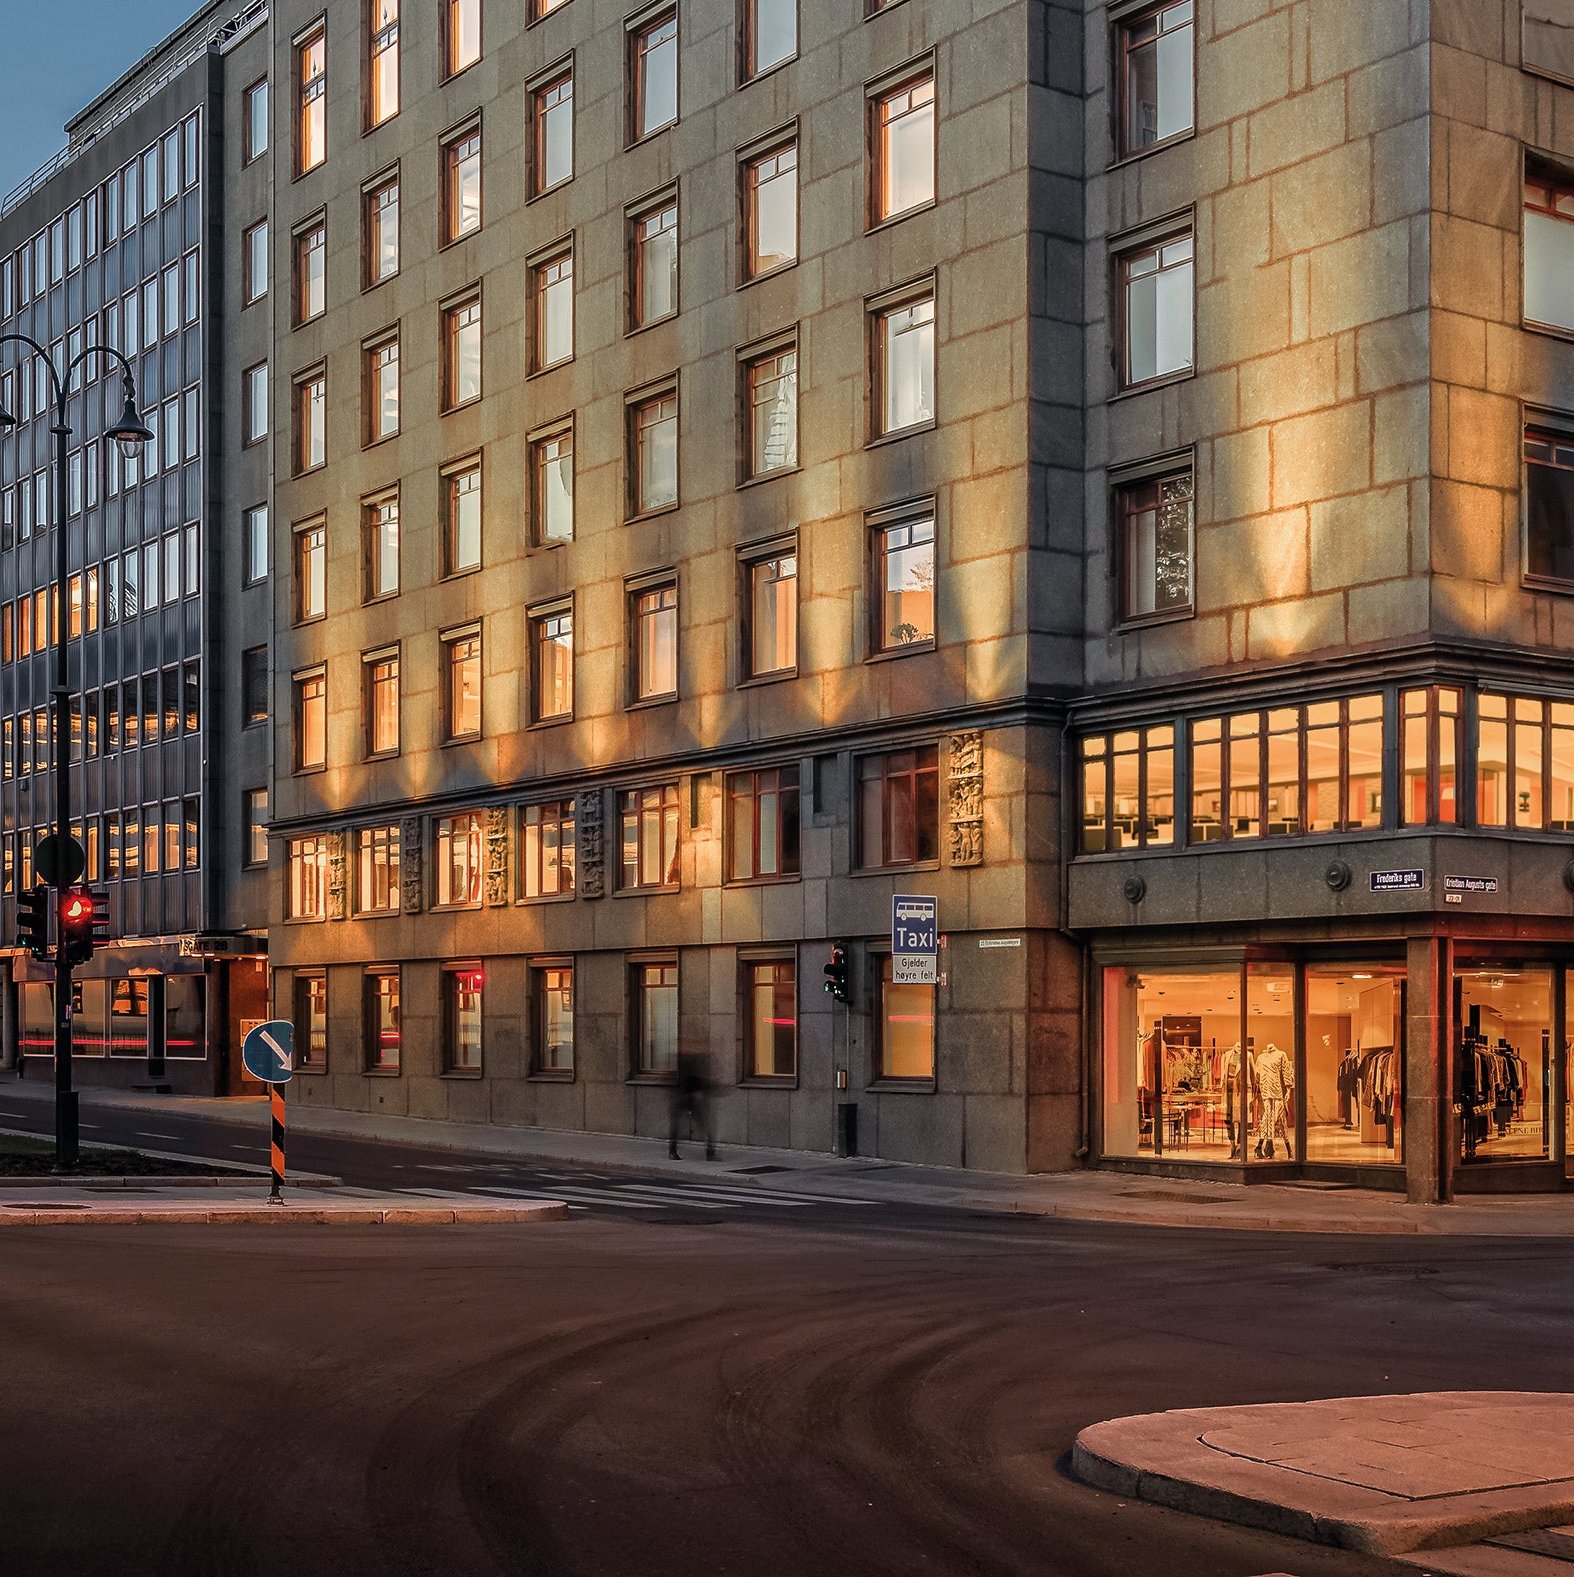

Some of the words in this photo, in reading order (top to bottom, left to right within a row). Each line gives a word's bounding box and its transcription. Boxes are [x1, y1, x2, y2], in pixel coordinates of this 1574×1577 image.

[1376, 873, 1403, 883] Frederiks
[1403, 872, 1417, 884] gate
[1446, 878, 1465, 888] Kristian
[1465, 879, 1485, 891] Augusts
[1485, 881, 1496, 892] gate
[897, 927, 933, 948] Taxi
[901, 957, 928, 969] Gjelder
[895, 970, 917, 981] høyre
[920, 969, 934, 980] felt
